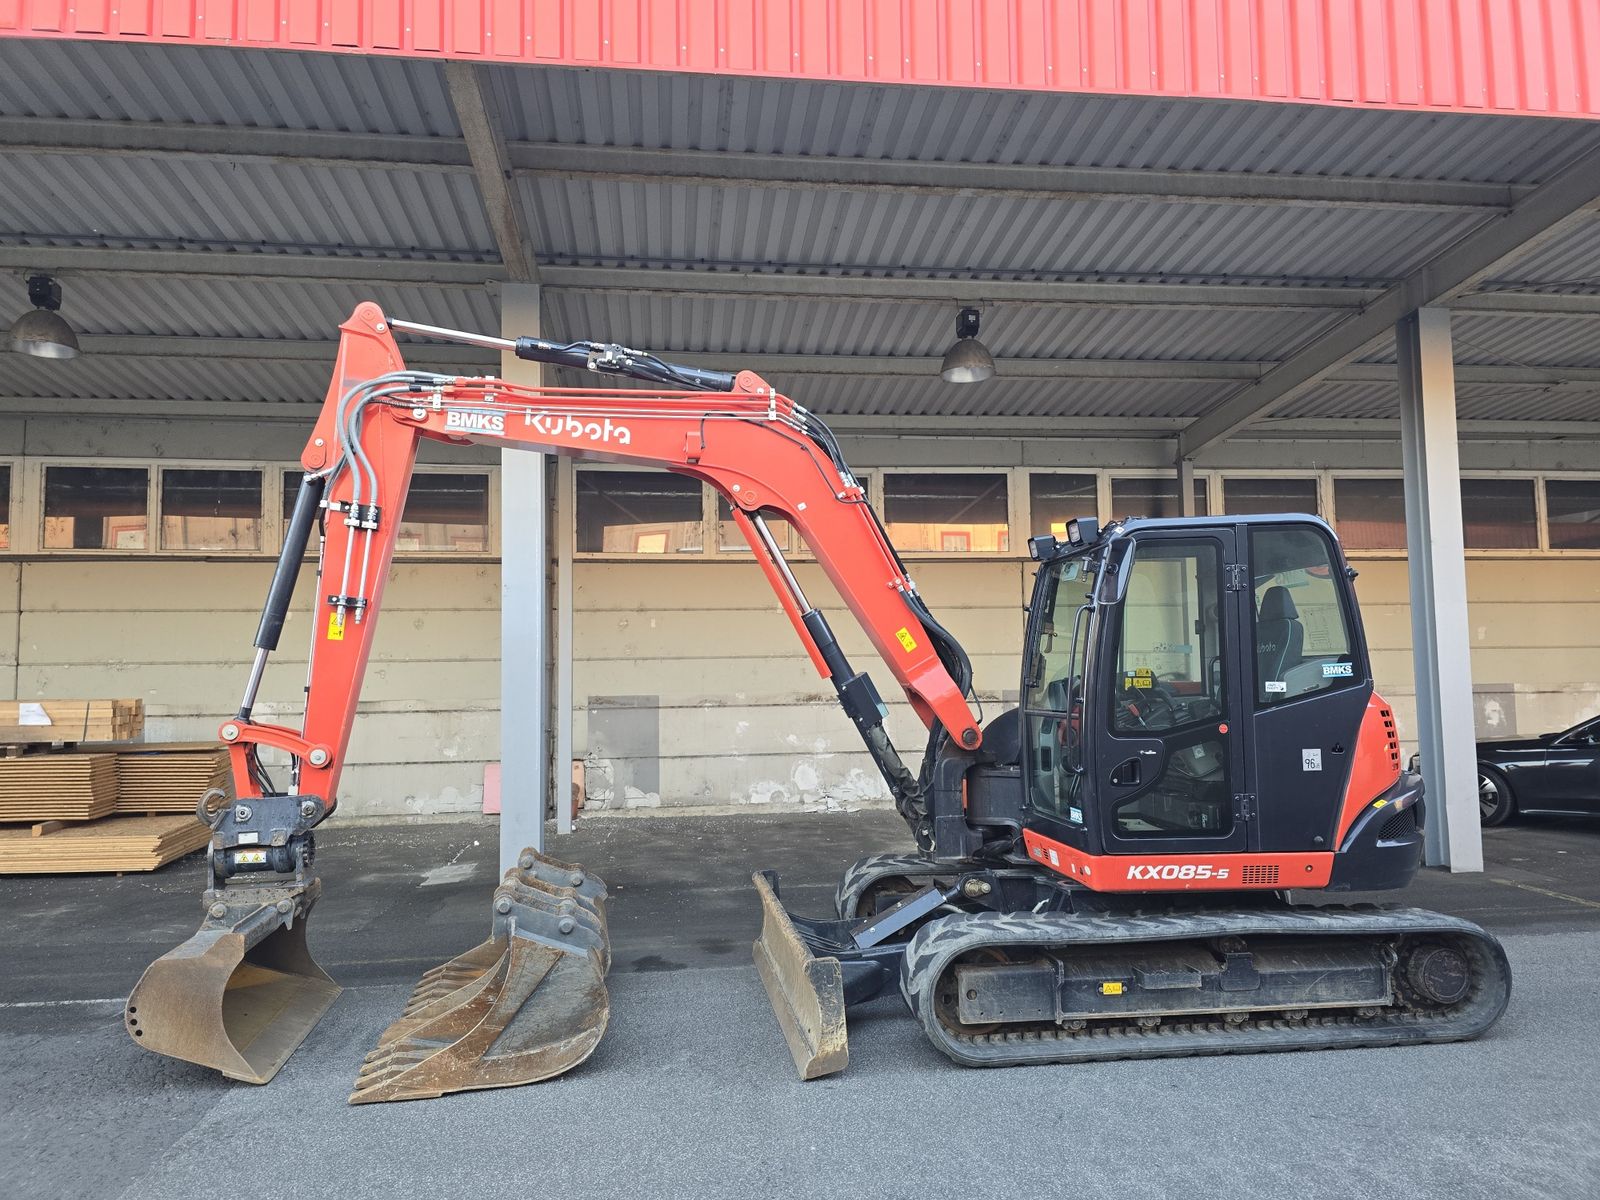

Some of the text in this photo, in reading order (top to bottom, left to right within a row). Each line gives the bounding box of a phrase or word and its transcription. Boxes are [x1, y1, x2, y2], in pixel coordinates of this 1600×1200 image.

[447, 411, 504, 430] BMKS
[525, 408, 631, 444] Kubota
[1323, 665, 1352, 675] BMKS
[1304, 758, 1316, 769] 96
